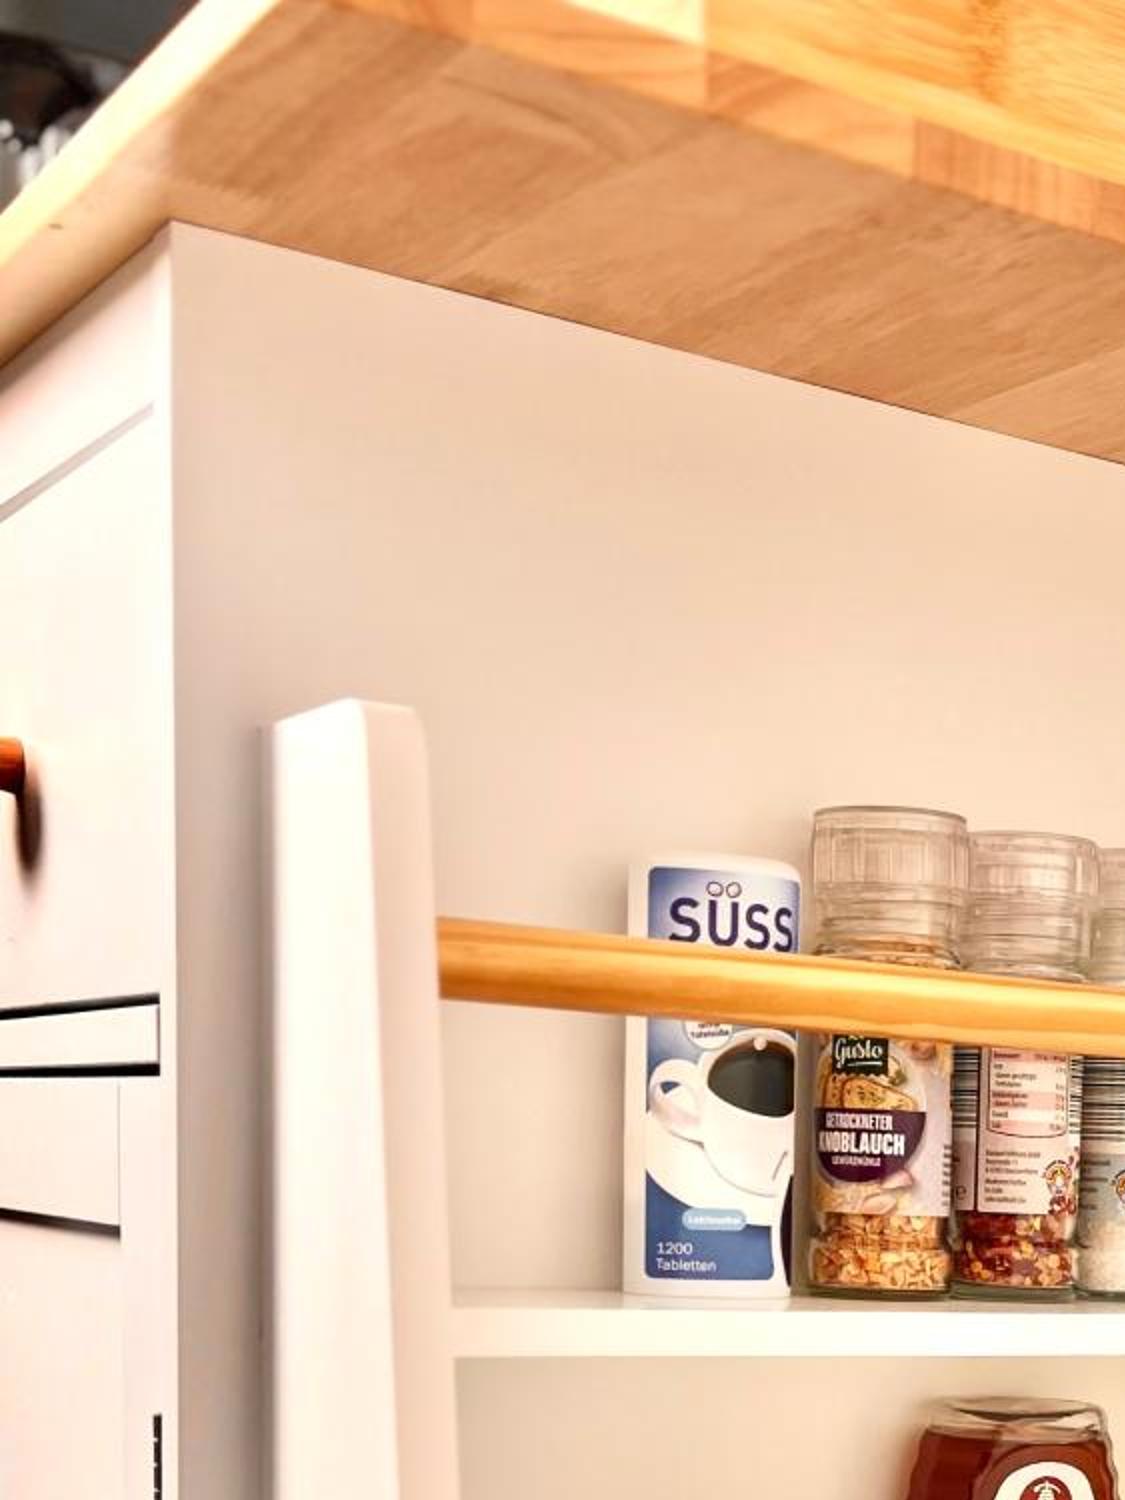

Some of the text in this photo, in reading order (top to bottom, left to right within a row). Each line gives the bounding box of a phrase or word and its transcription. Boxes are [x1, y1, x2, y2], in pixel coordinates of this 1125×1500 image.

[669, 881, 793, 952] SÜSS
[835, 1038, 884, 1069] Gusto
[818, 1131, 905, 1157] KNOBLAUCH
[656, 1242, 694, 1255] 1200
[655, 1257, 718, 1272] Tabletten
